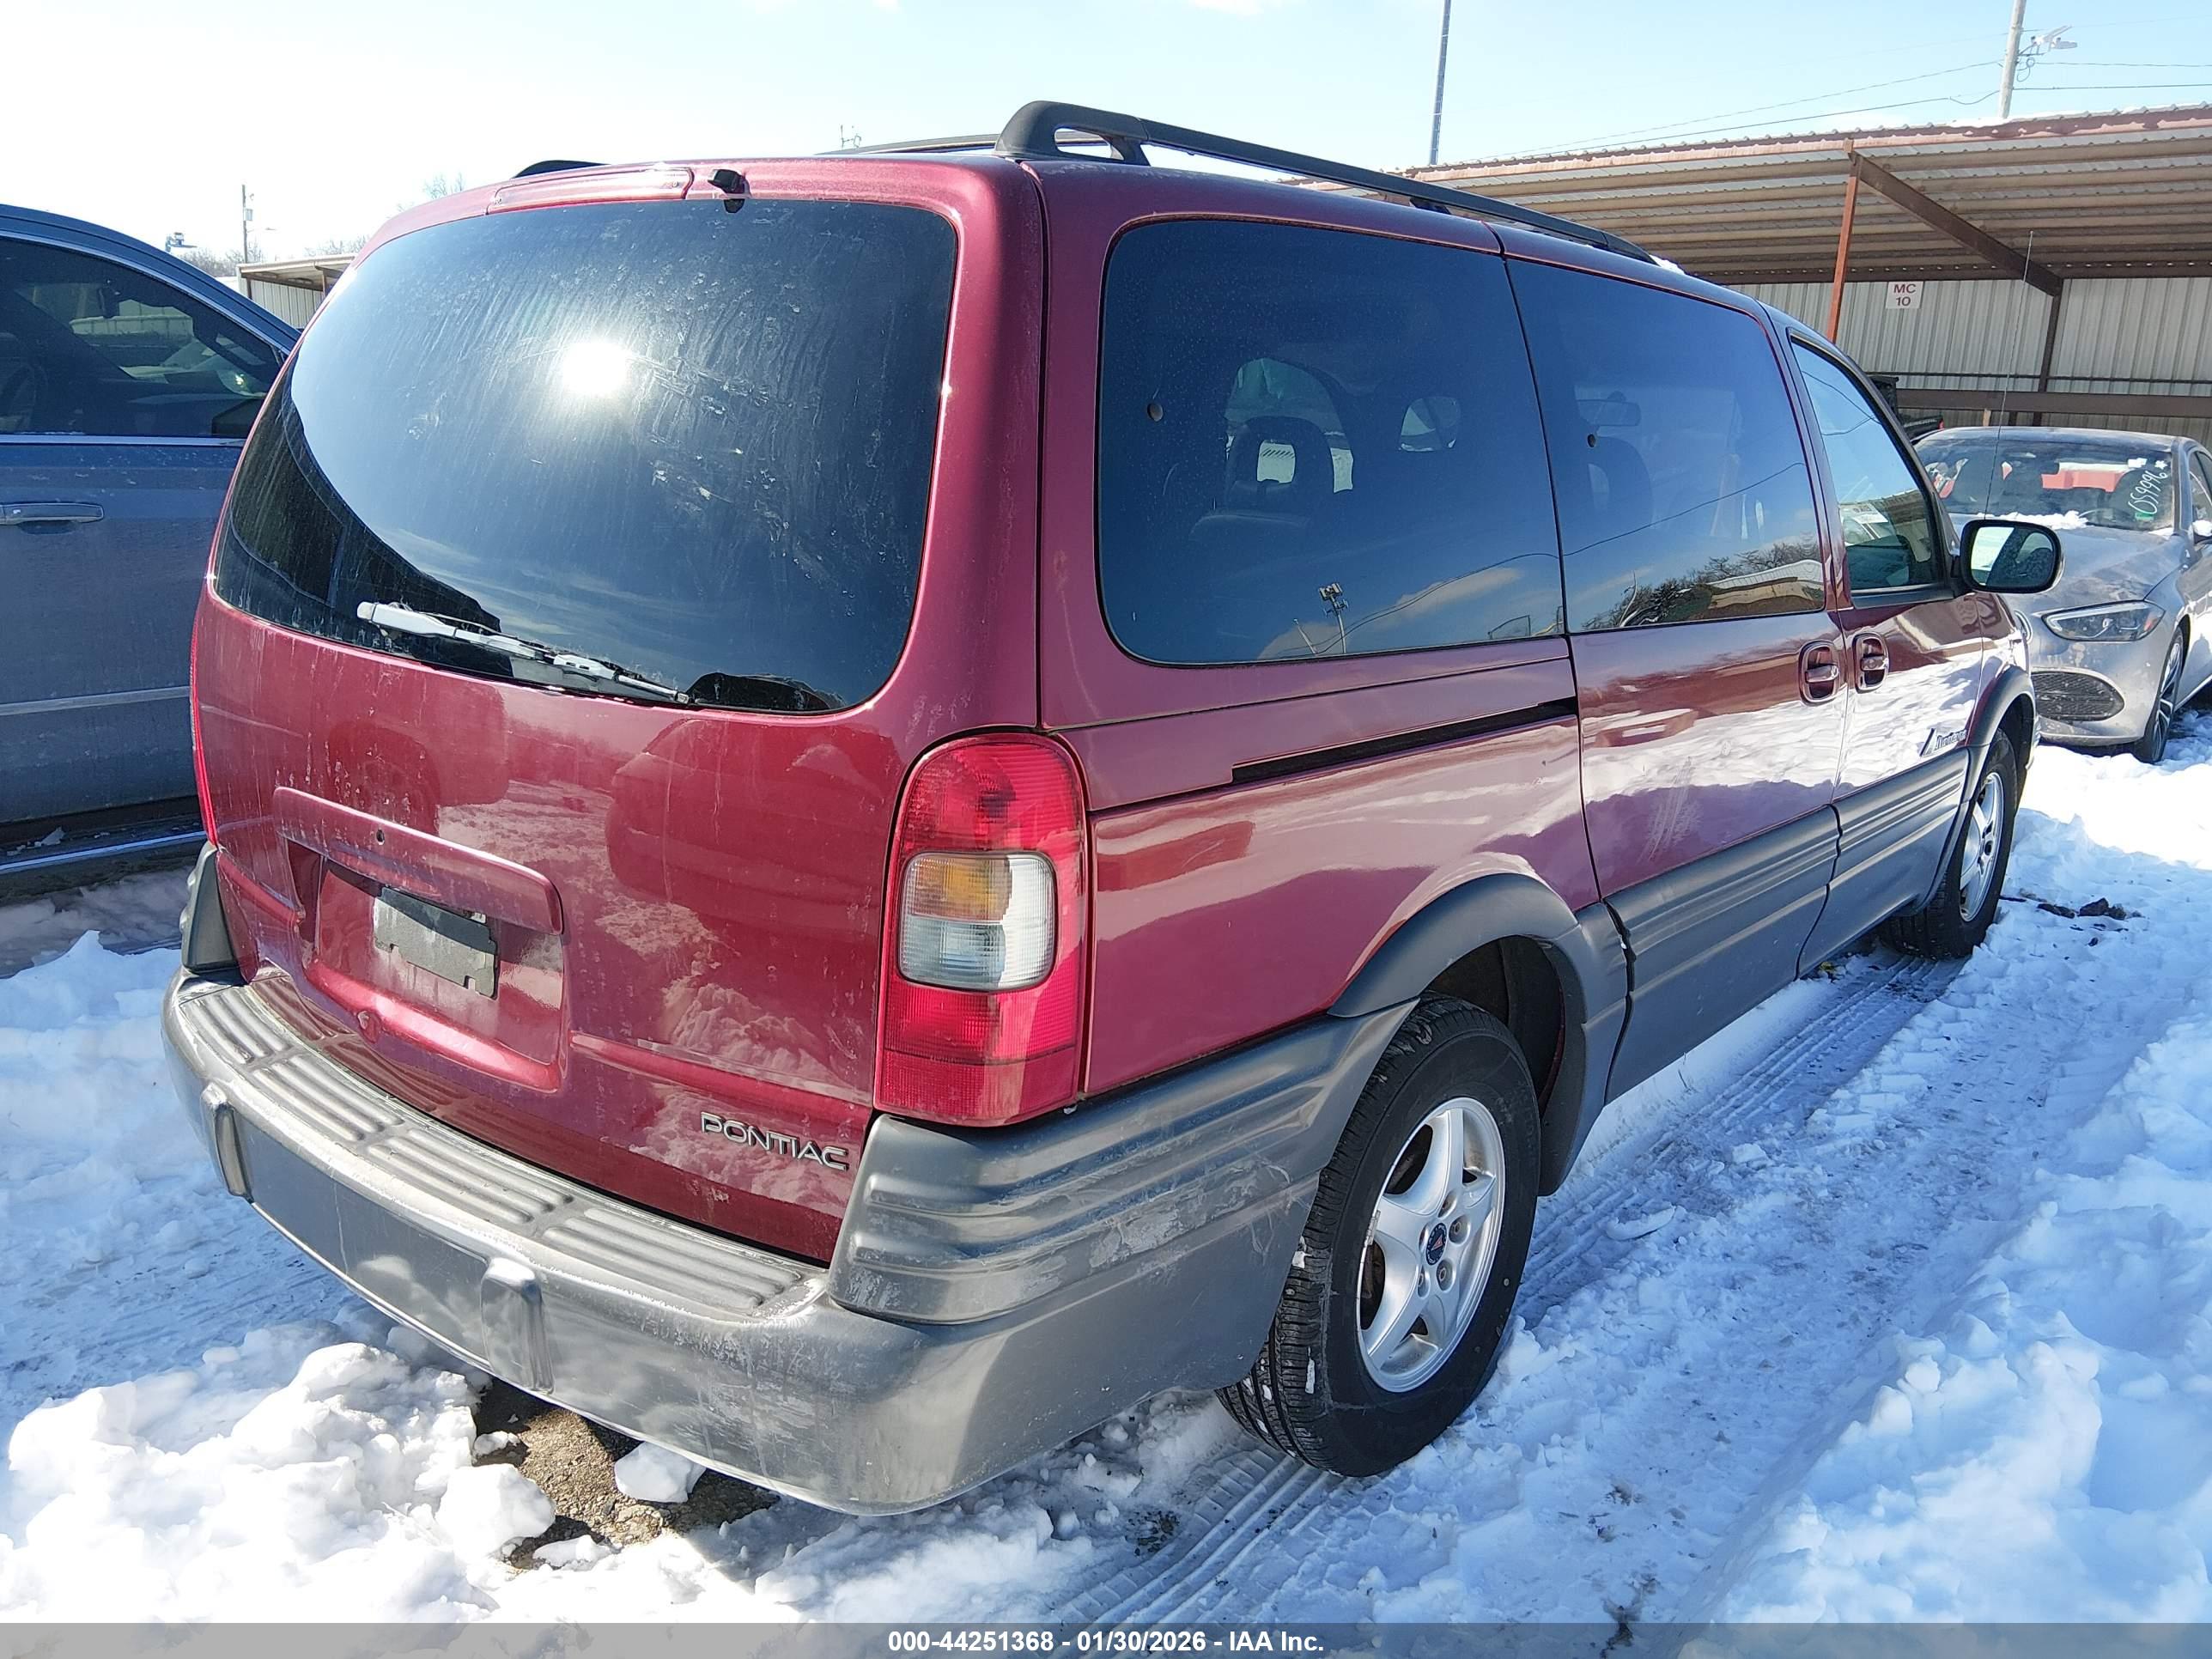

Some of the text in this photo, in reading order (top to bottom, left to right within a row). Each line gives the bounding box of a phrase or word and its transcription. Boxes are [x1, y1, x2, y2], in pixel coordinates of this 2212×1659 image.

[1893, 283, 1917, 294] MC
[1895, 296, 1911, 307] 10
[700, 1111, 849, 1171] PONTIAC
